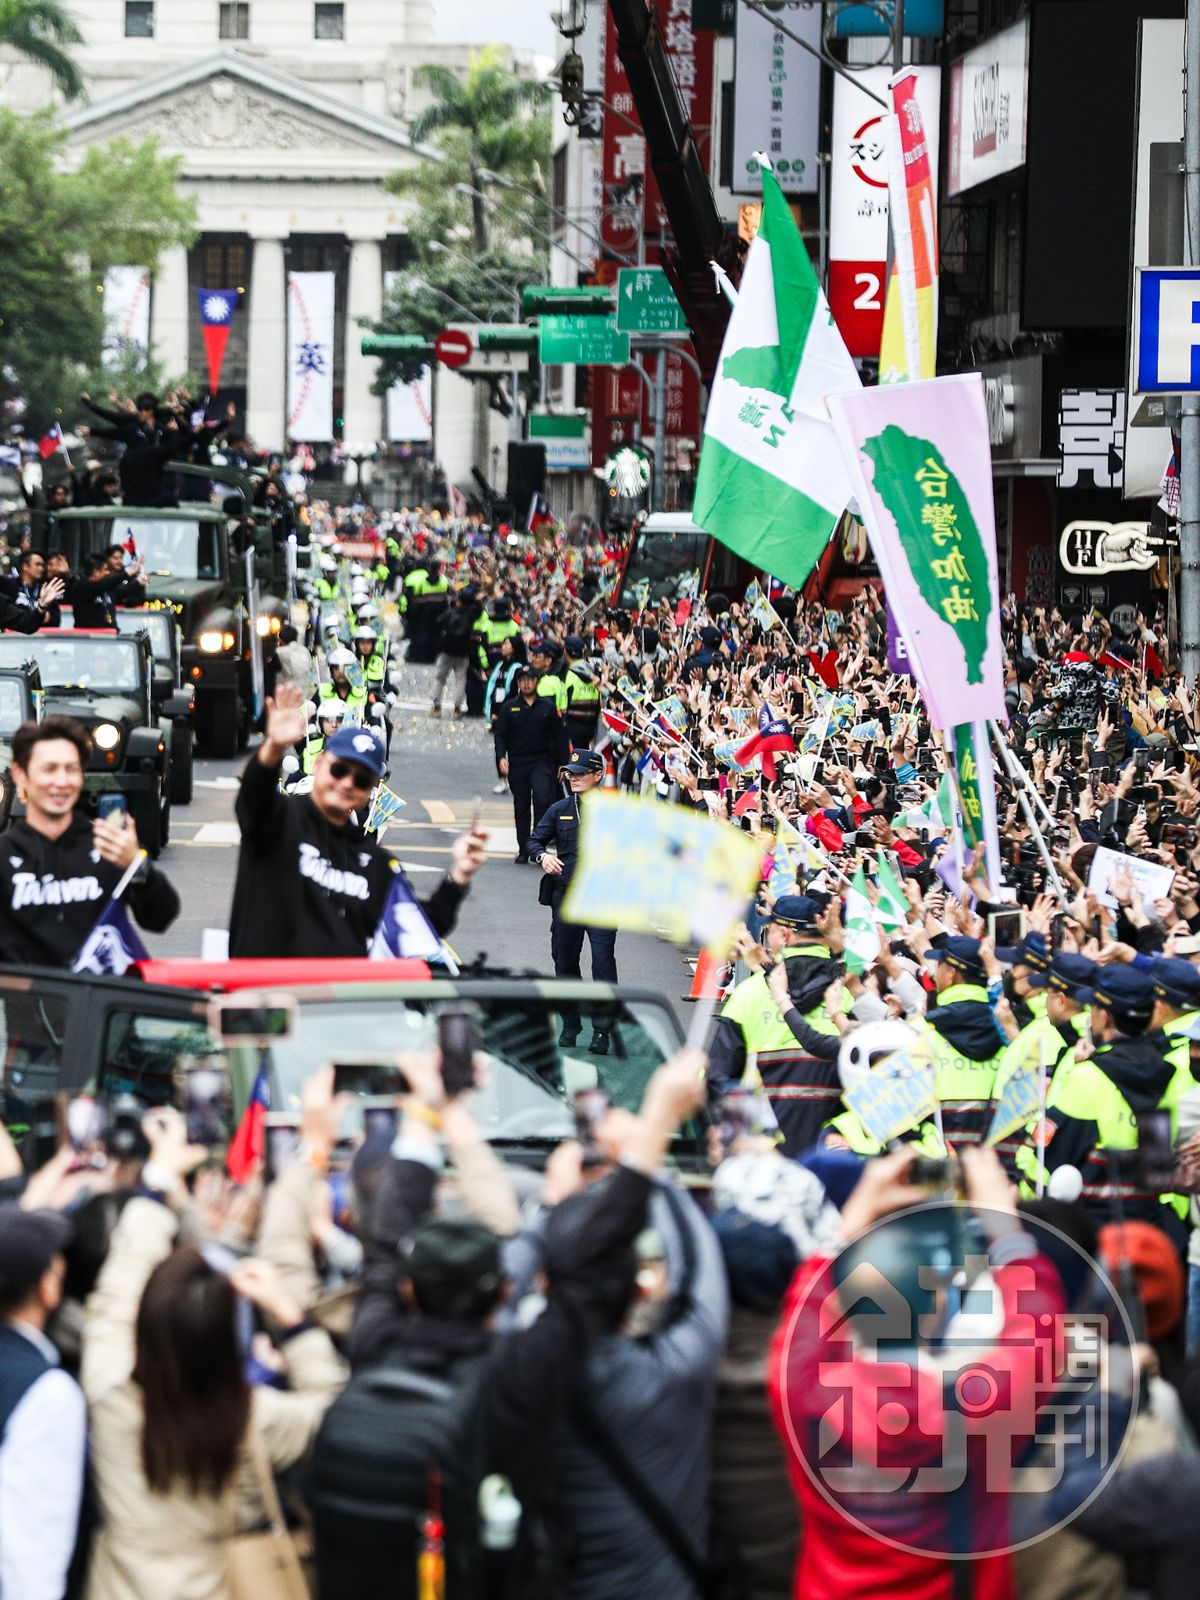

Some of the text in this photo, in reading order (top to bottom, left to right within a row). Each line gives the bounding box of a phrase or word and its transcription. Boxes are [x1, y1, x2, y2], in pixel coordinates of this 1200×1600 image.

[853, 272, 881, 310] 2
[11, 872, 104, 911] Taiwan
[939, 1057, 1001, 1071] POLIC
